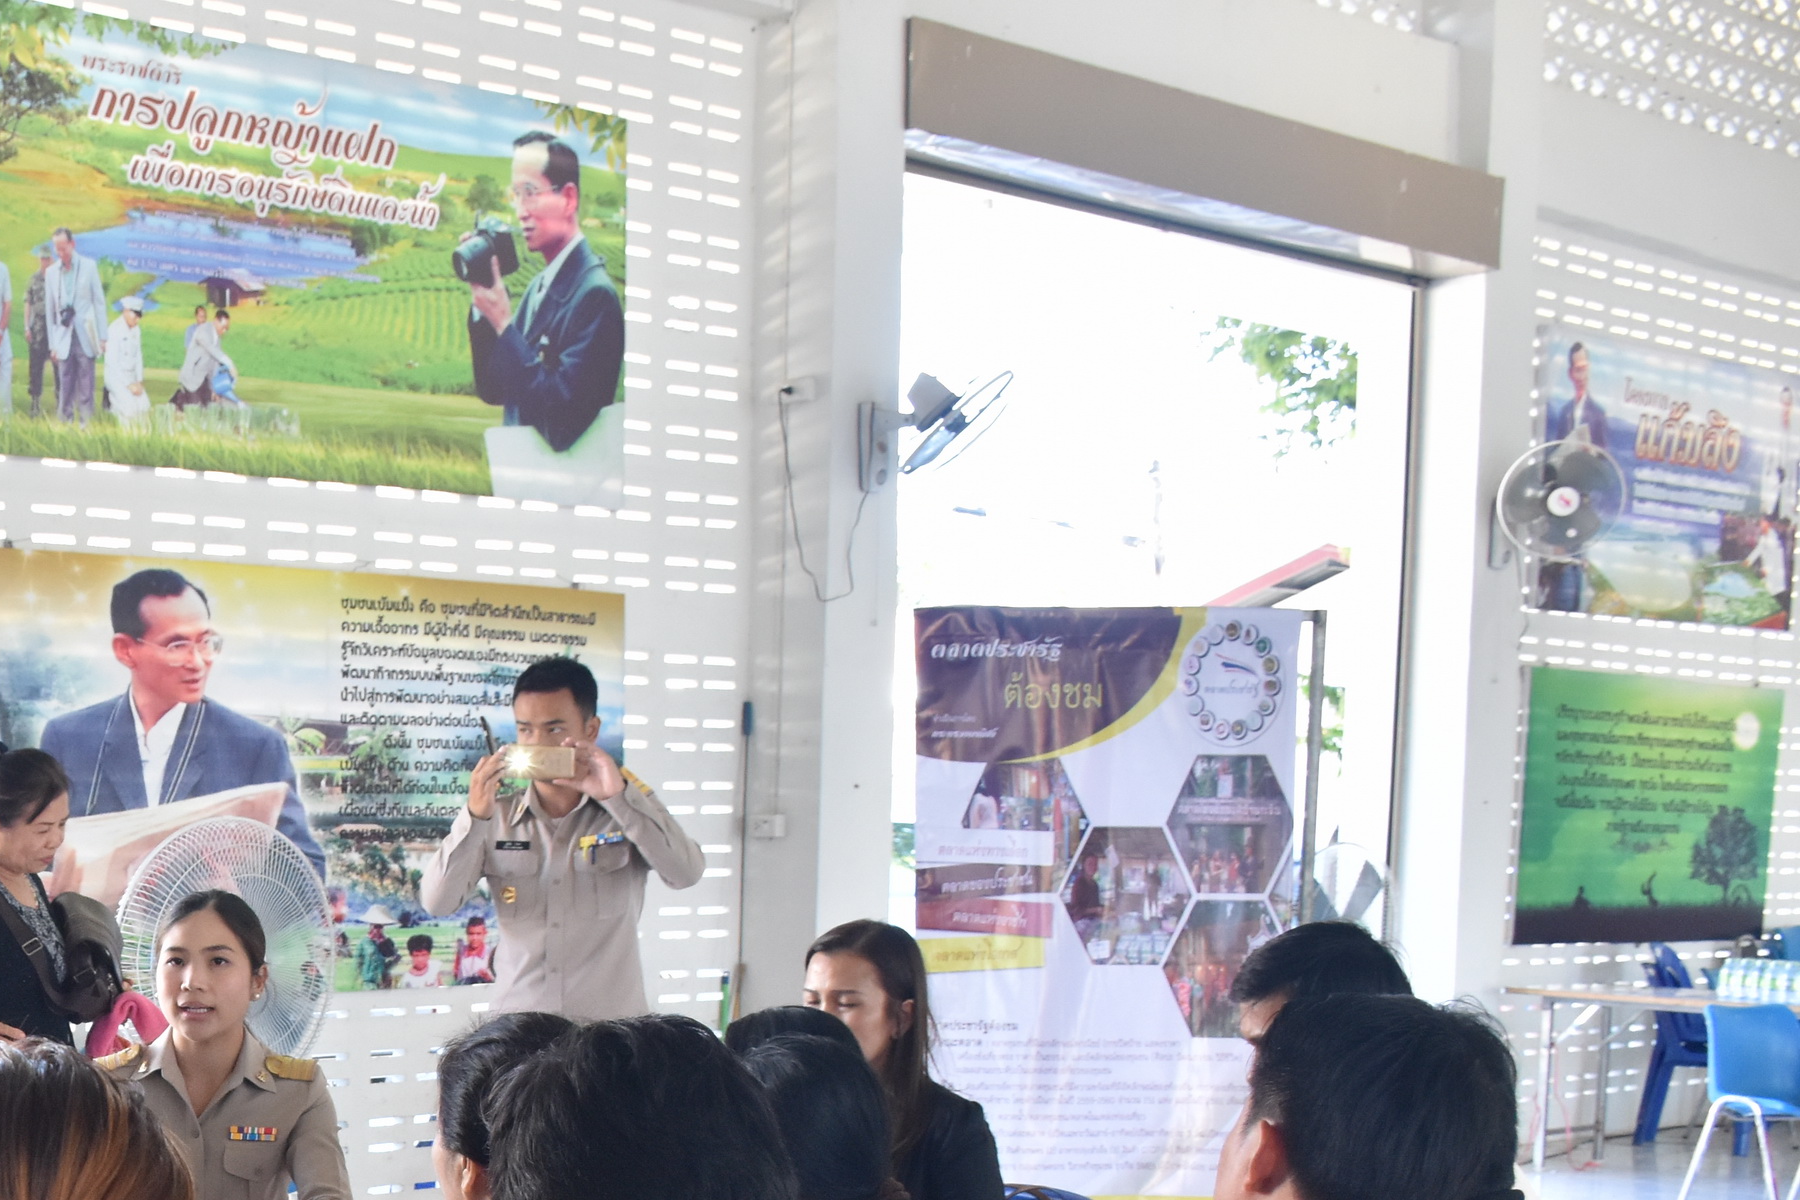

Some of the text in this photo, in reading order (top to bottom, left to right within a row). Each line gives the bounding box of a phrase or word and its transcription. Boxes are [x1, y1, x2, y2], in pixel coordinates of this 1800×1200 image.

[89, 86, 398, 168] การปลูกหญ้าแฝก
[420, 598, 436, 613] คือ
[930, 636, 1063, 661] ตลาดประชารัฐ
[1003, 673, 1103, 709] ต้องชม
